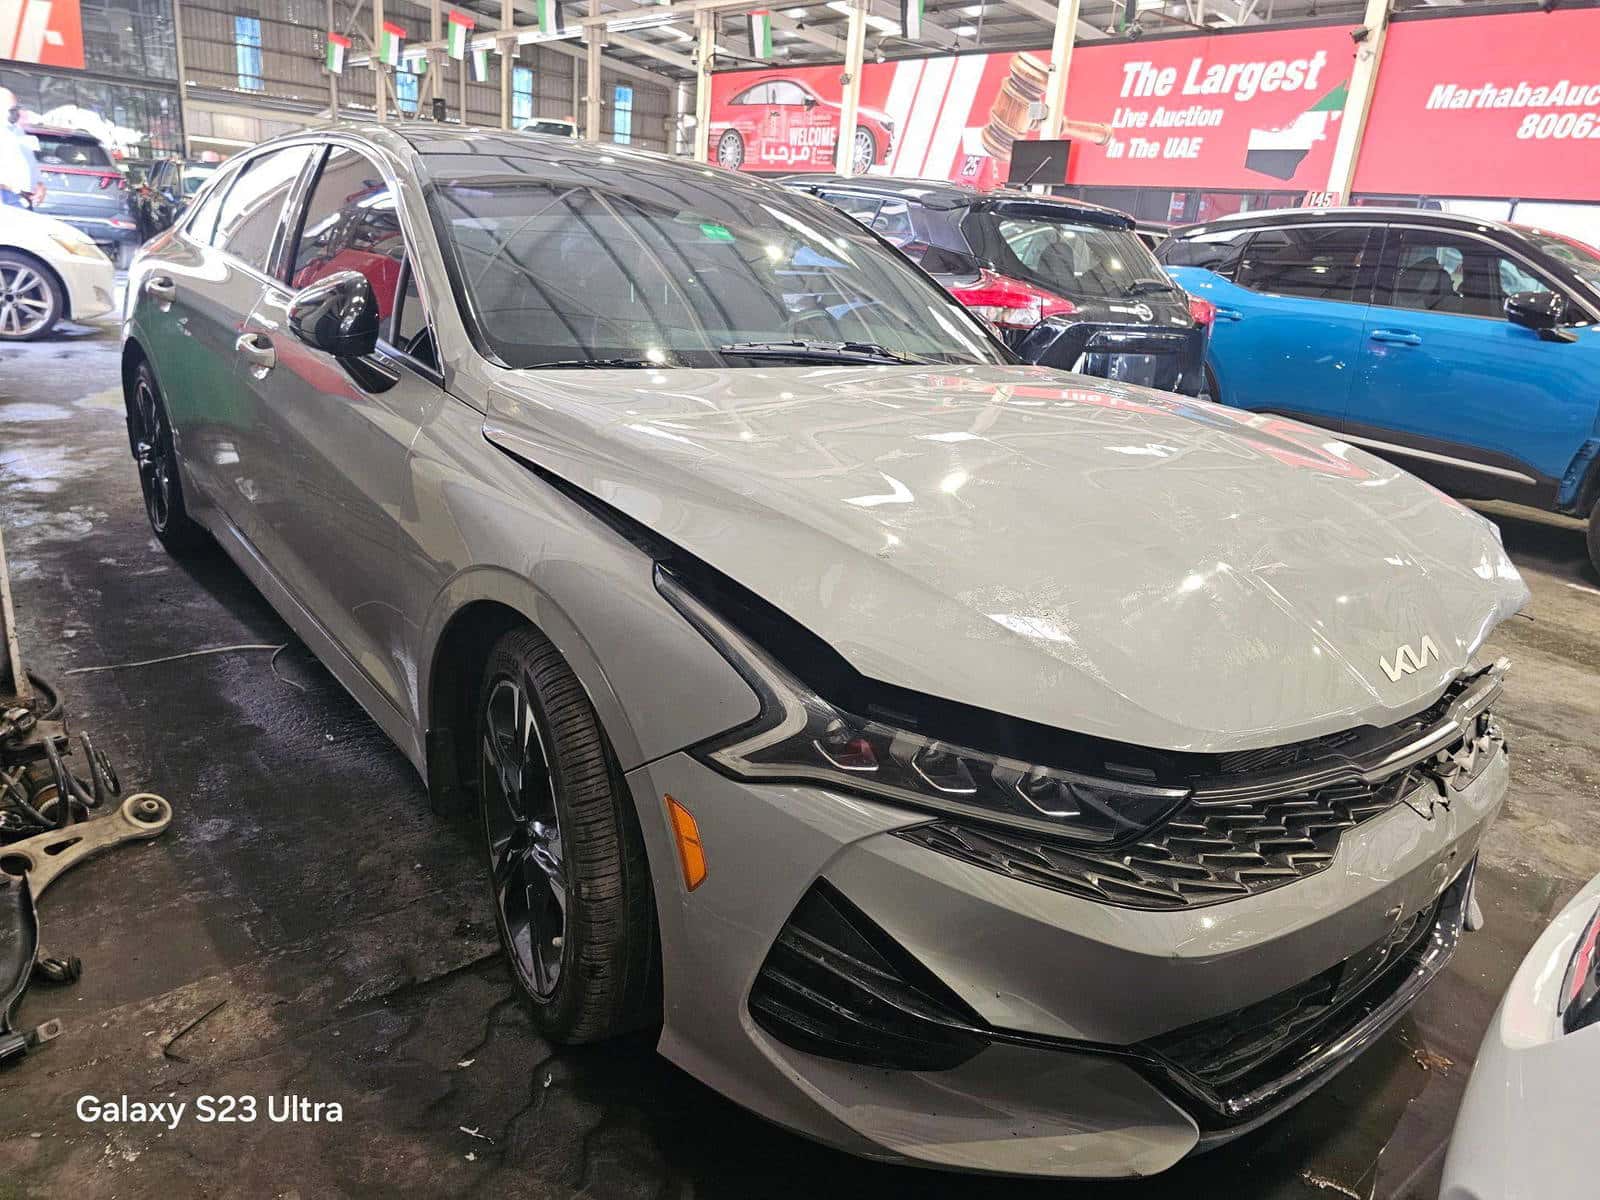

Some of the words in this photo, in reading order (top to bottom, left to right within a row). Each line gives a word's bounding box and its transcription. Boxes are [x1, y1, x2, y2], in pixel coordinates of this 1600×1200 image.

[1120, 61, 1177, 97] The
[1182, 51, 1328, 102] Largest
[1111, 107, 1149, 128] Live
[1150, 105, 1224, 128] Auction
[788, 127, 837, 147] WELCOME
[1105, 138, 1125, 158] In
[1128, 137, 1161, 159] The
[1163, 137, 1204, 158] UAE
[760, 140, 811, 165] مرحبا
[1309, 192, 1332, 207] 145
